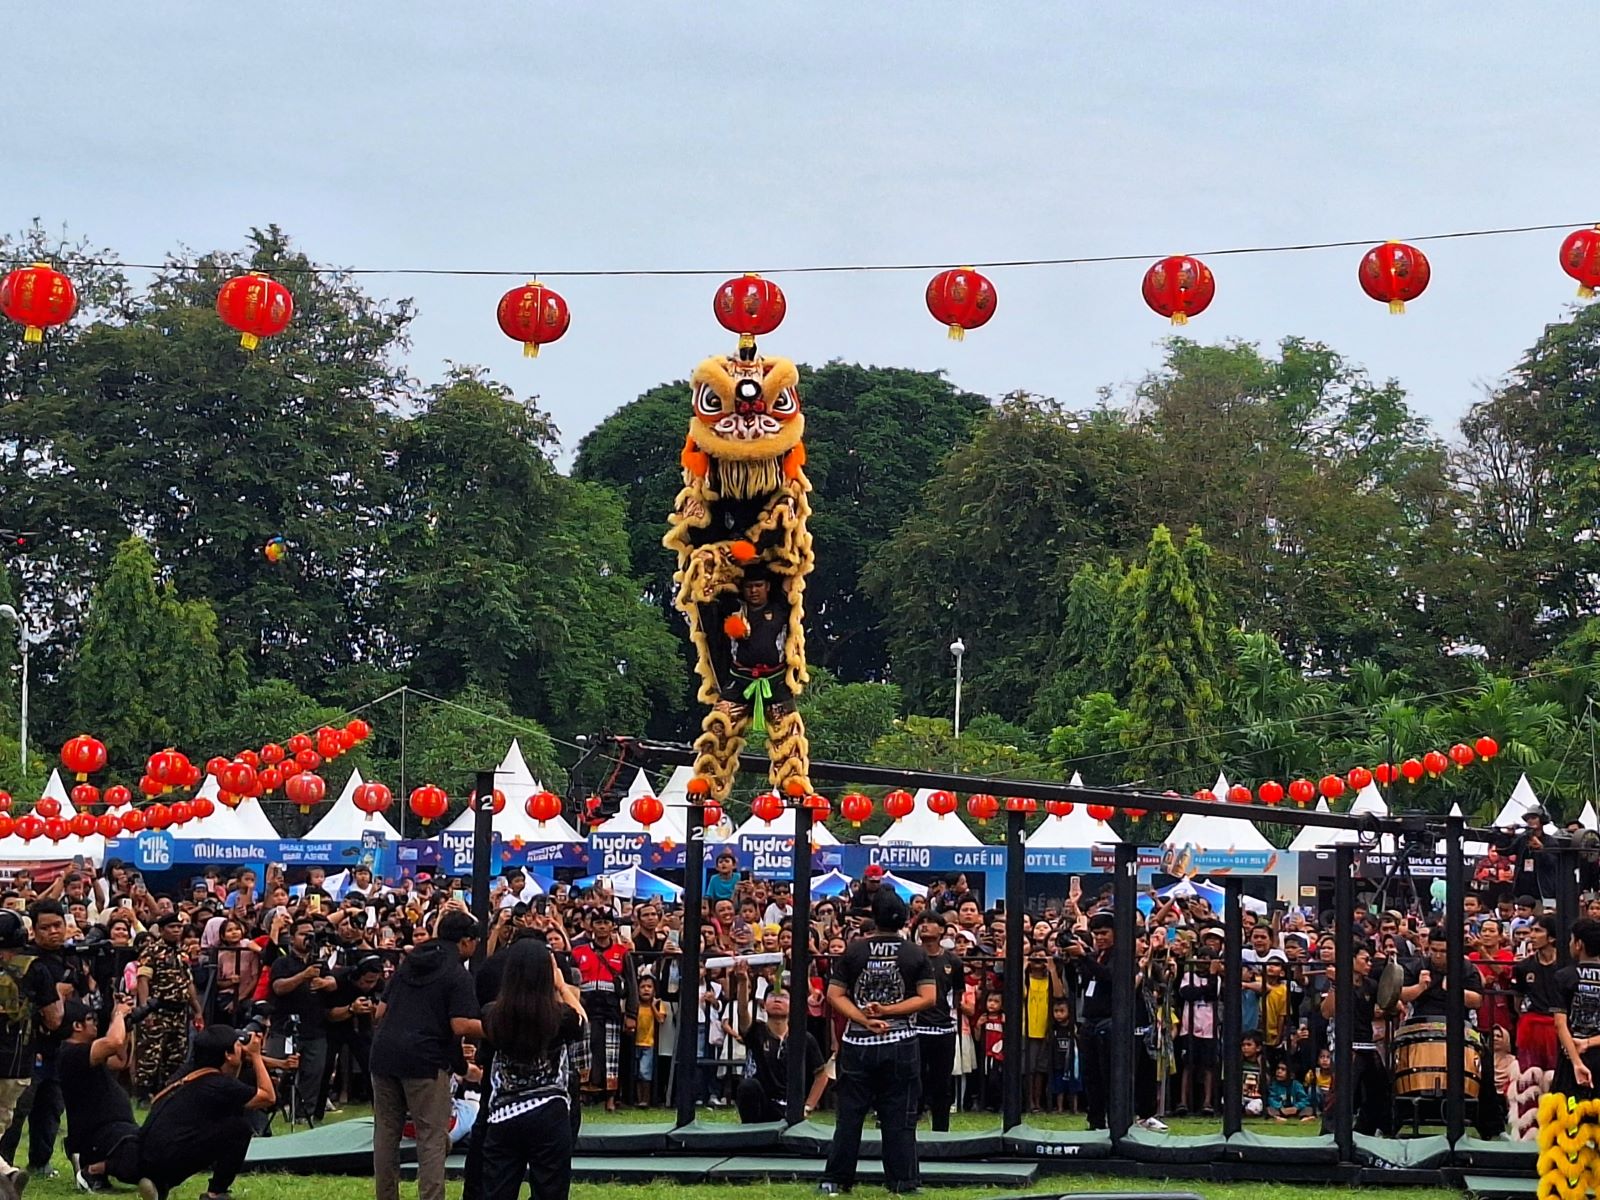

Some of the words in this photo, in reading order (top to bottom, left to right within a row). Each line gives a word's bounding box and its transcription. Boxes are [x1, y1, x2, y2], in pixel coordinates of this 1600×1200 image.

[139, 836, 169, 850] Milk
[443, 832, 475, 852] hyd
[592, 834, 643, 854] hydro
[742, 836, 793, 856] hydro
[143, 849, 169, 864] Life
[454, 849, 474, 868] pl
[604, 850, 642, 869] plus
[753, 852, 792, 871] plus
[954, 850, 988, 866] CAFÉ
[990, 854, 1003, 866] IN
[1025, 855, 1067, 866] OTTLE
[869, 942, 902, 956] WTF
[1576, 966, 1600, 980] WT
